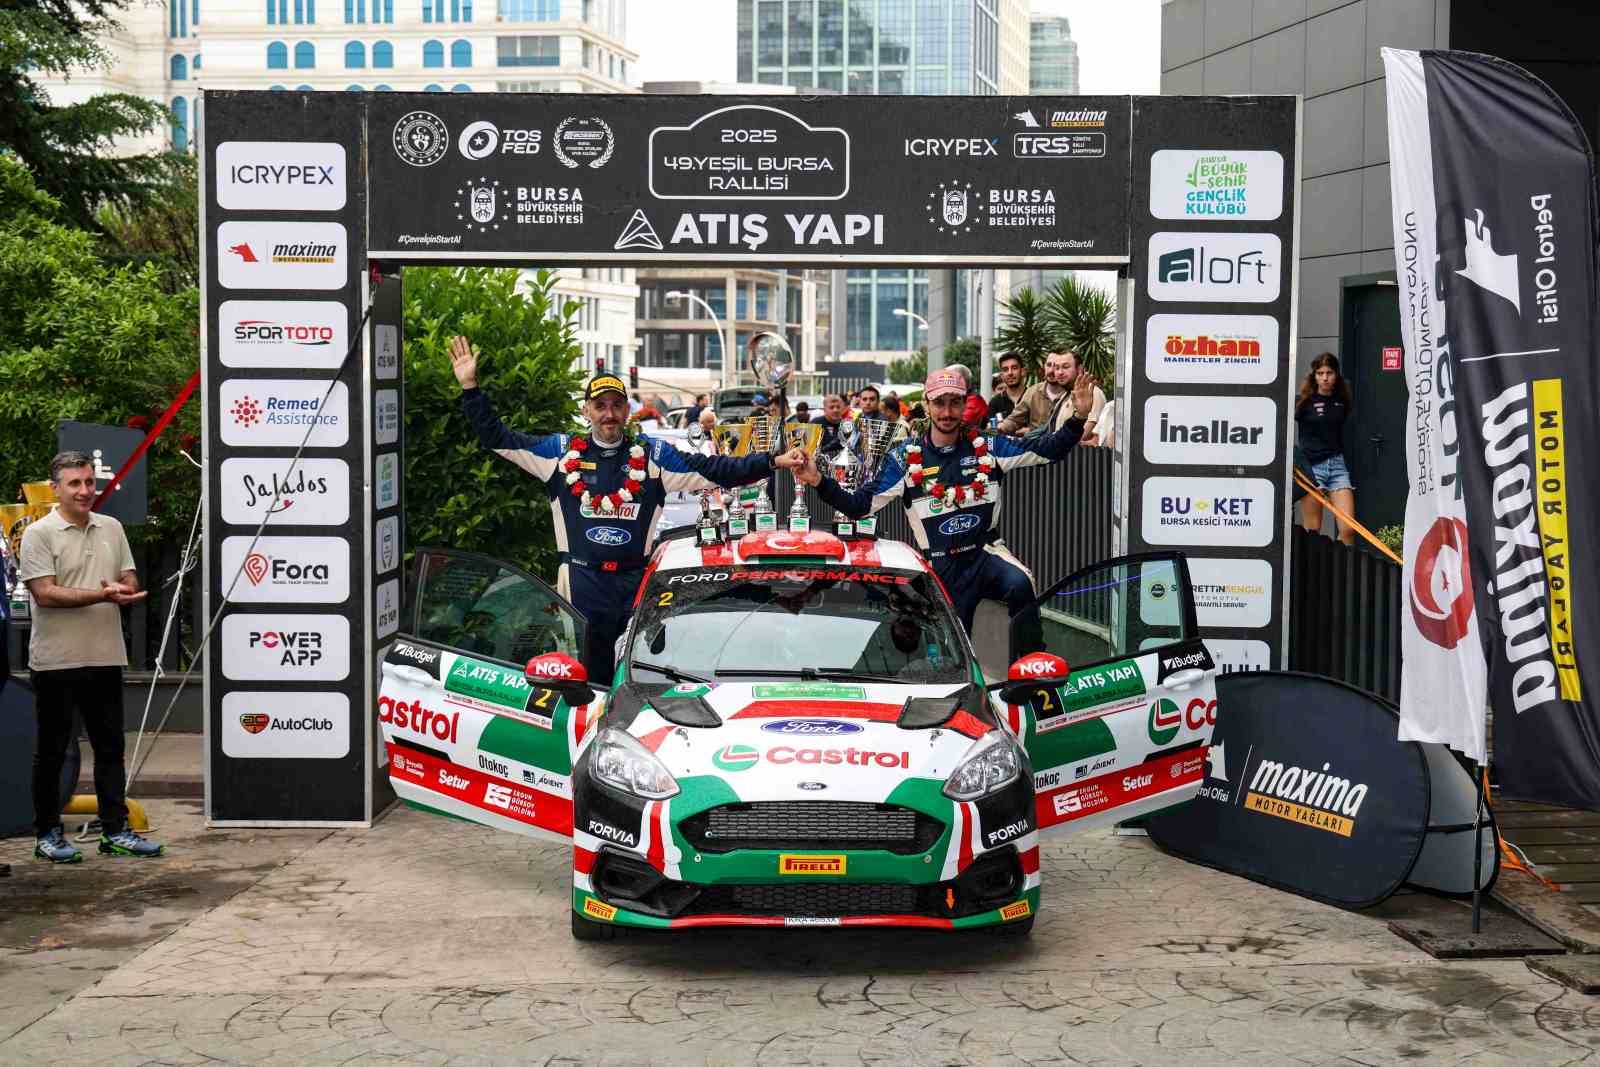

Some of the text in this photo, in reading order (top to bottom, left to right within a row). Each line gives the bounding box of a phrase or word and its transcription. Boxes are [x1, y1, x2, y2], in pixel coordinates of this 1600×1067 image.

[1051, 107, 1108, 121] maxima
[502, 129, 542, 142] TOS
[720, 129, 778, 143] 2025
[501, 142, 541, 154] FED
[904, 138, 999, 156] ICRYPEX
[1017, 136, 1070, 155] TRS
[757, 157, 834, 171] BURSA
[231, 165, 334, 184] ICRYPEX
[708, 174, 789, 190] RALLİSİ
[516, 187, 583, 200] BURSA
[989, 189, 1056, 203] BURSA
[1186, 188, 1247, 202] GENÇLİK
[516, 202, 583, 214] BÜYÜKŞEHİR
[989, 203, 1056, 216] BÜYÜKŞEHİR
[1185, 201, 1247, 215] KULÜBÜ
[516, 213, 584, 224] BELEDİYESİ
[989, 215, 1056, 226] BELEDİYESİ
[669, 212, 884, 251] ATIŞ YAPI
[272, 240, 337, 257] maxima
[1160, 246, 1267, 285] aloft
[266, 397, 320, 411] Remed
[266, 411, 338, 426] Assistance
[243, 469, 328, 508] Salados
[1213, 497, 1253, 516] KET
[1160, 516, 1252, 527] BURSA KESİCİ TAKIM
[271, 559, 330, 580] Fora
[668, 569, 911, 586] FORD PERFORMANCE
[658, 592, 674, 607] 2
[249, 631, 323, 649] POWER
[280, 650, 323, 666] APP
[404, 646, 437, 664] Budget
[1174, 651, 1206, 668] Budget
[468, 666, 501, 685] ATIŞ
[535, 663, 572, 677] NGK
[1019, 661, 1057, 675] NGK
[1077, 665, 1137, 688] ATIŞ YAPI
[535, 688, 553, 708] 2
[1037, 689, 1054, 711] 2
[270, 718, 333, 731] AutoClub
[378, 695, 460, 744] astrol
[766, 745, 910, 769] Castrol
[478, 754, 509, 778] Otokoç
[438, 768, 471, 791] Setur
[1035, 772, 1060, 789] tokoç
[1122, 773, 1154, 792] Setur
[1249, 759, 1369, 817] maxima
[1211, 787, 1230, 803] Ofisi
[1255, 798, 1291, 816] MOTOR
[588, 819, 635, 846] FORVIA
[988, 818, 1029, 845] FORVIA
[784, 858, 840, 871] PIRELLI
